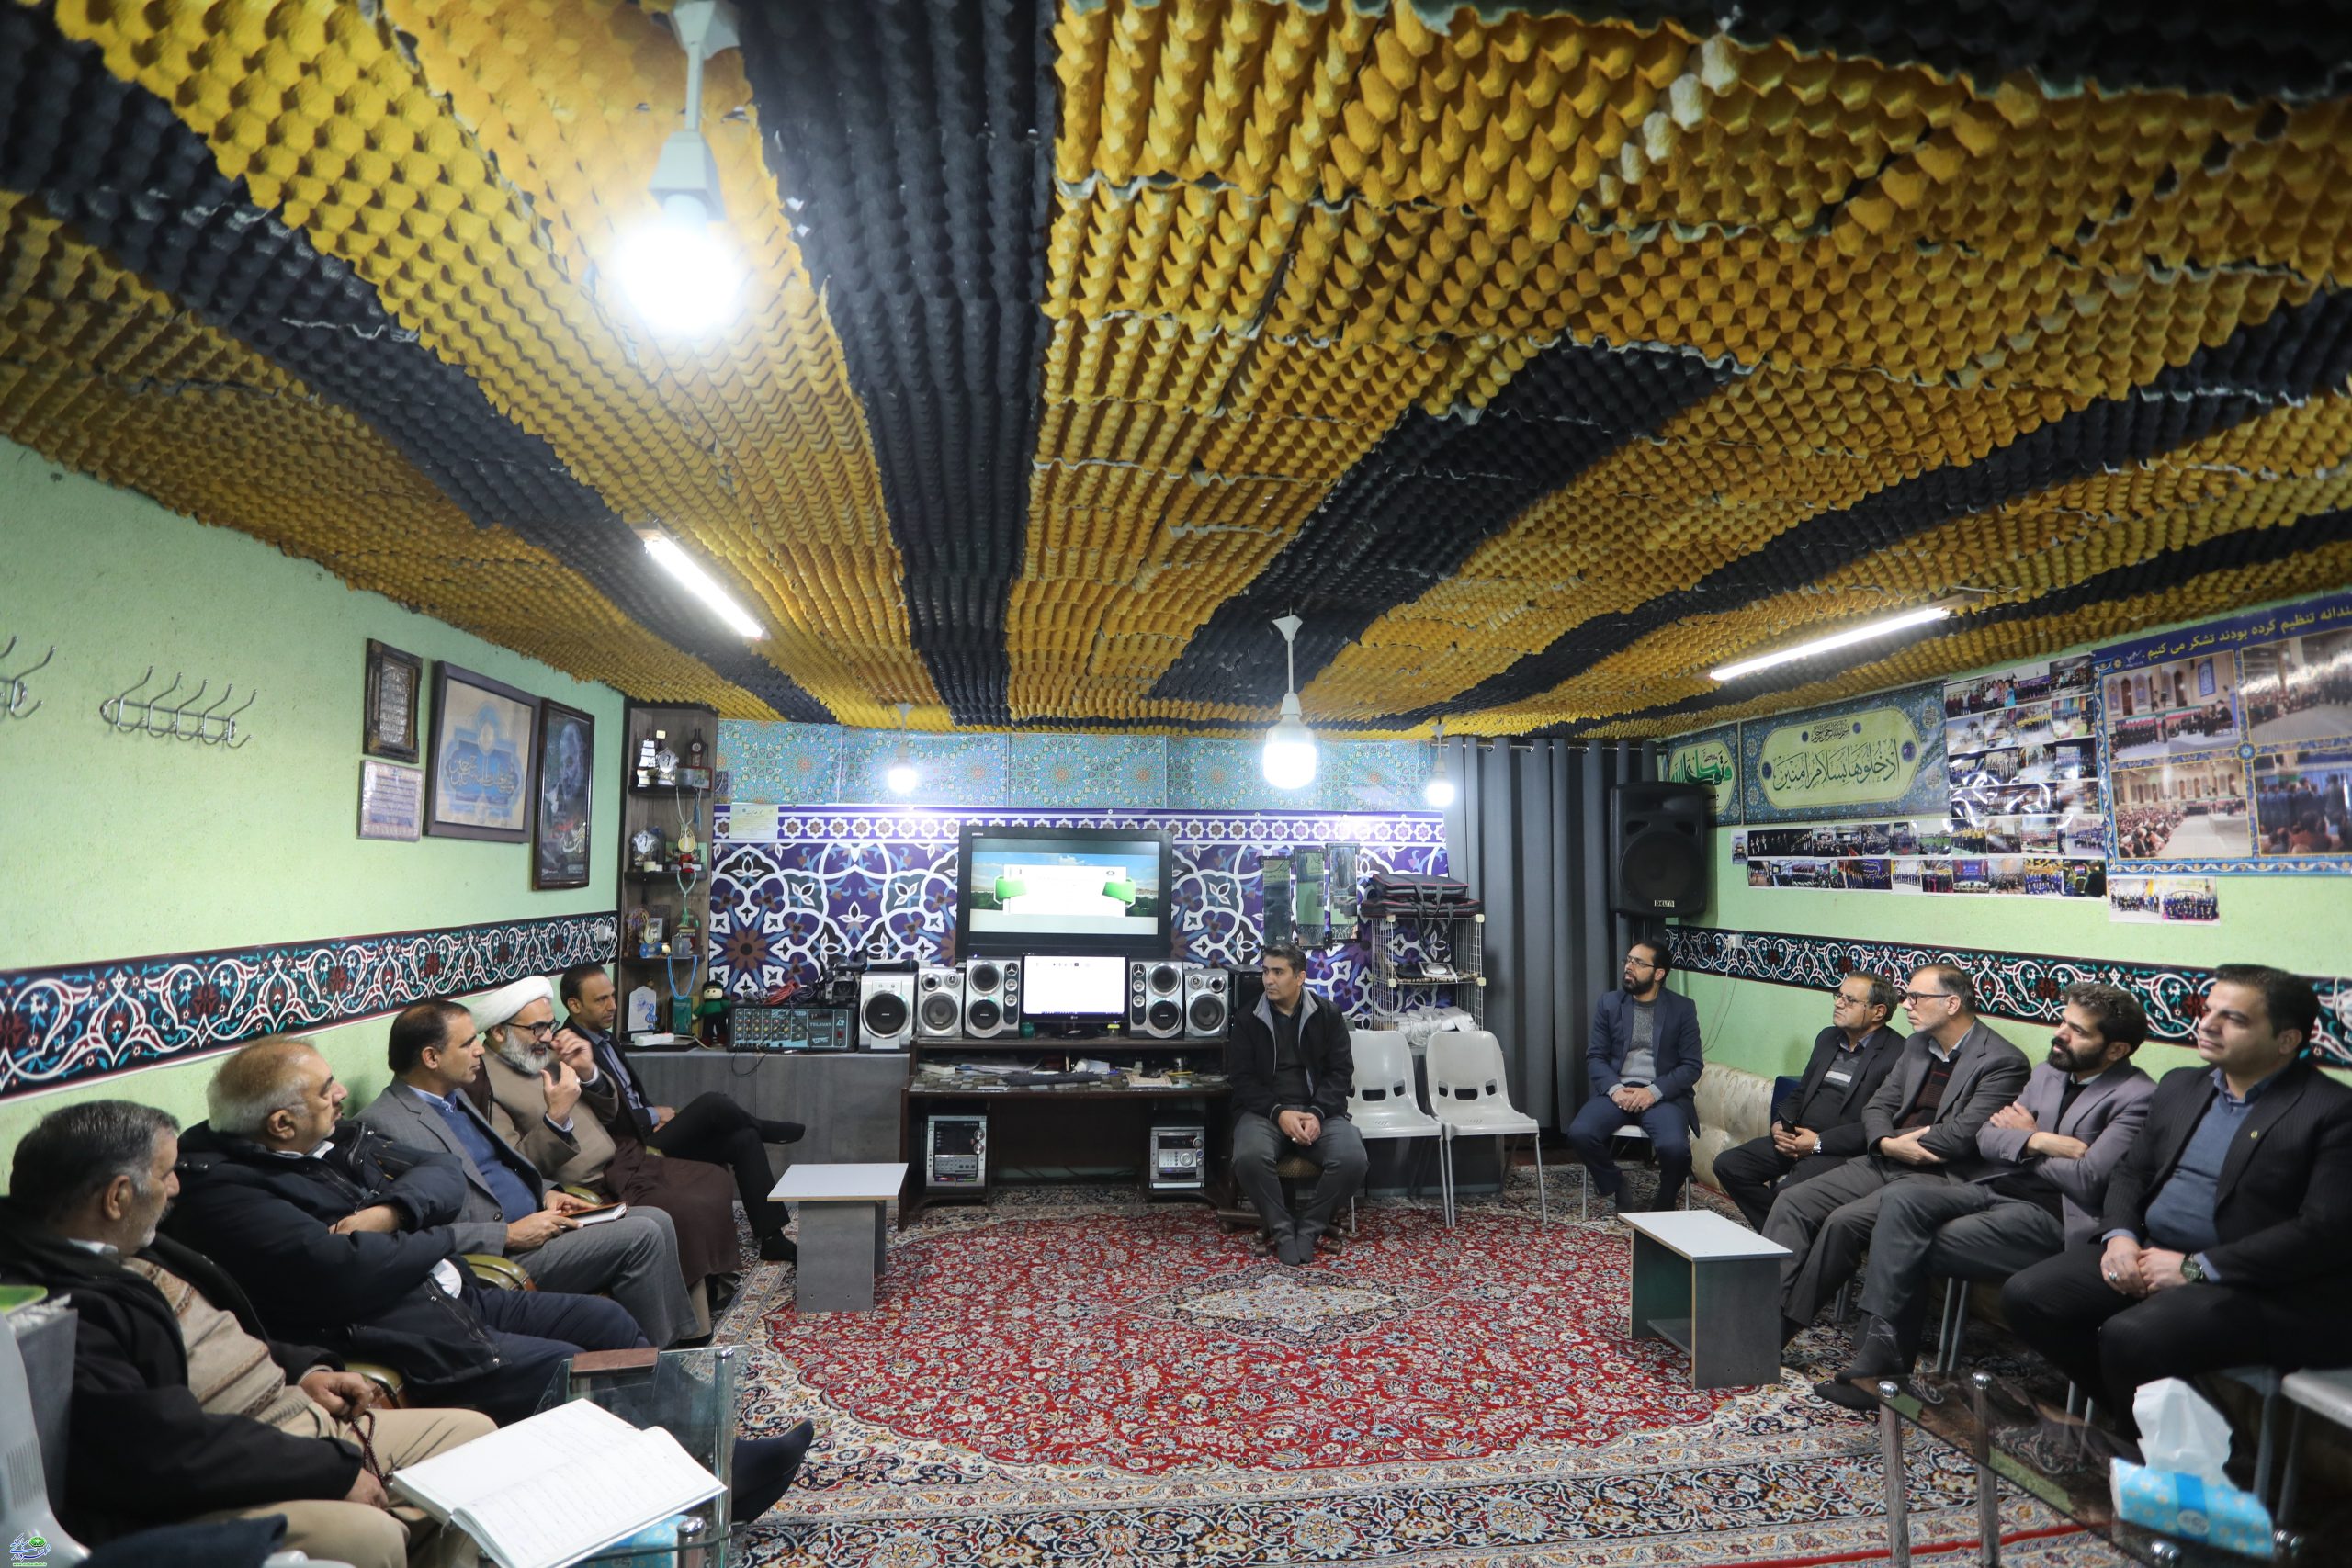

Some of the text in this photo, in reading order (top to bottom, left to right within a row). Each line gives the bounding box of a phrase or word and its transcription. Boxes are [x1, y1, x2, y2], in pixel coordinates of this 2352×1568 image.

[2251, 618, 2277, 636] کرده
[2280, 610, 2315, 635] تنظیم
[2188, 633, 2216, 650] تشکر
[2219, 629, 2248, 641] بودند
[2170, 642, 2186, 655] می
